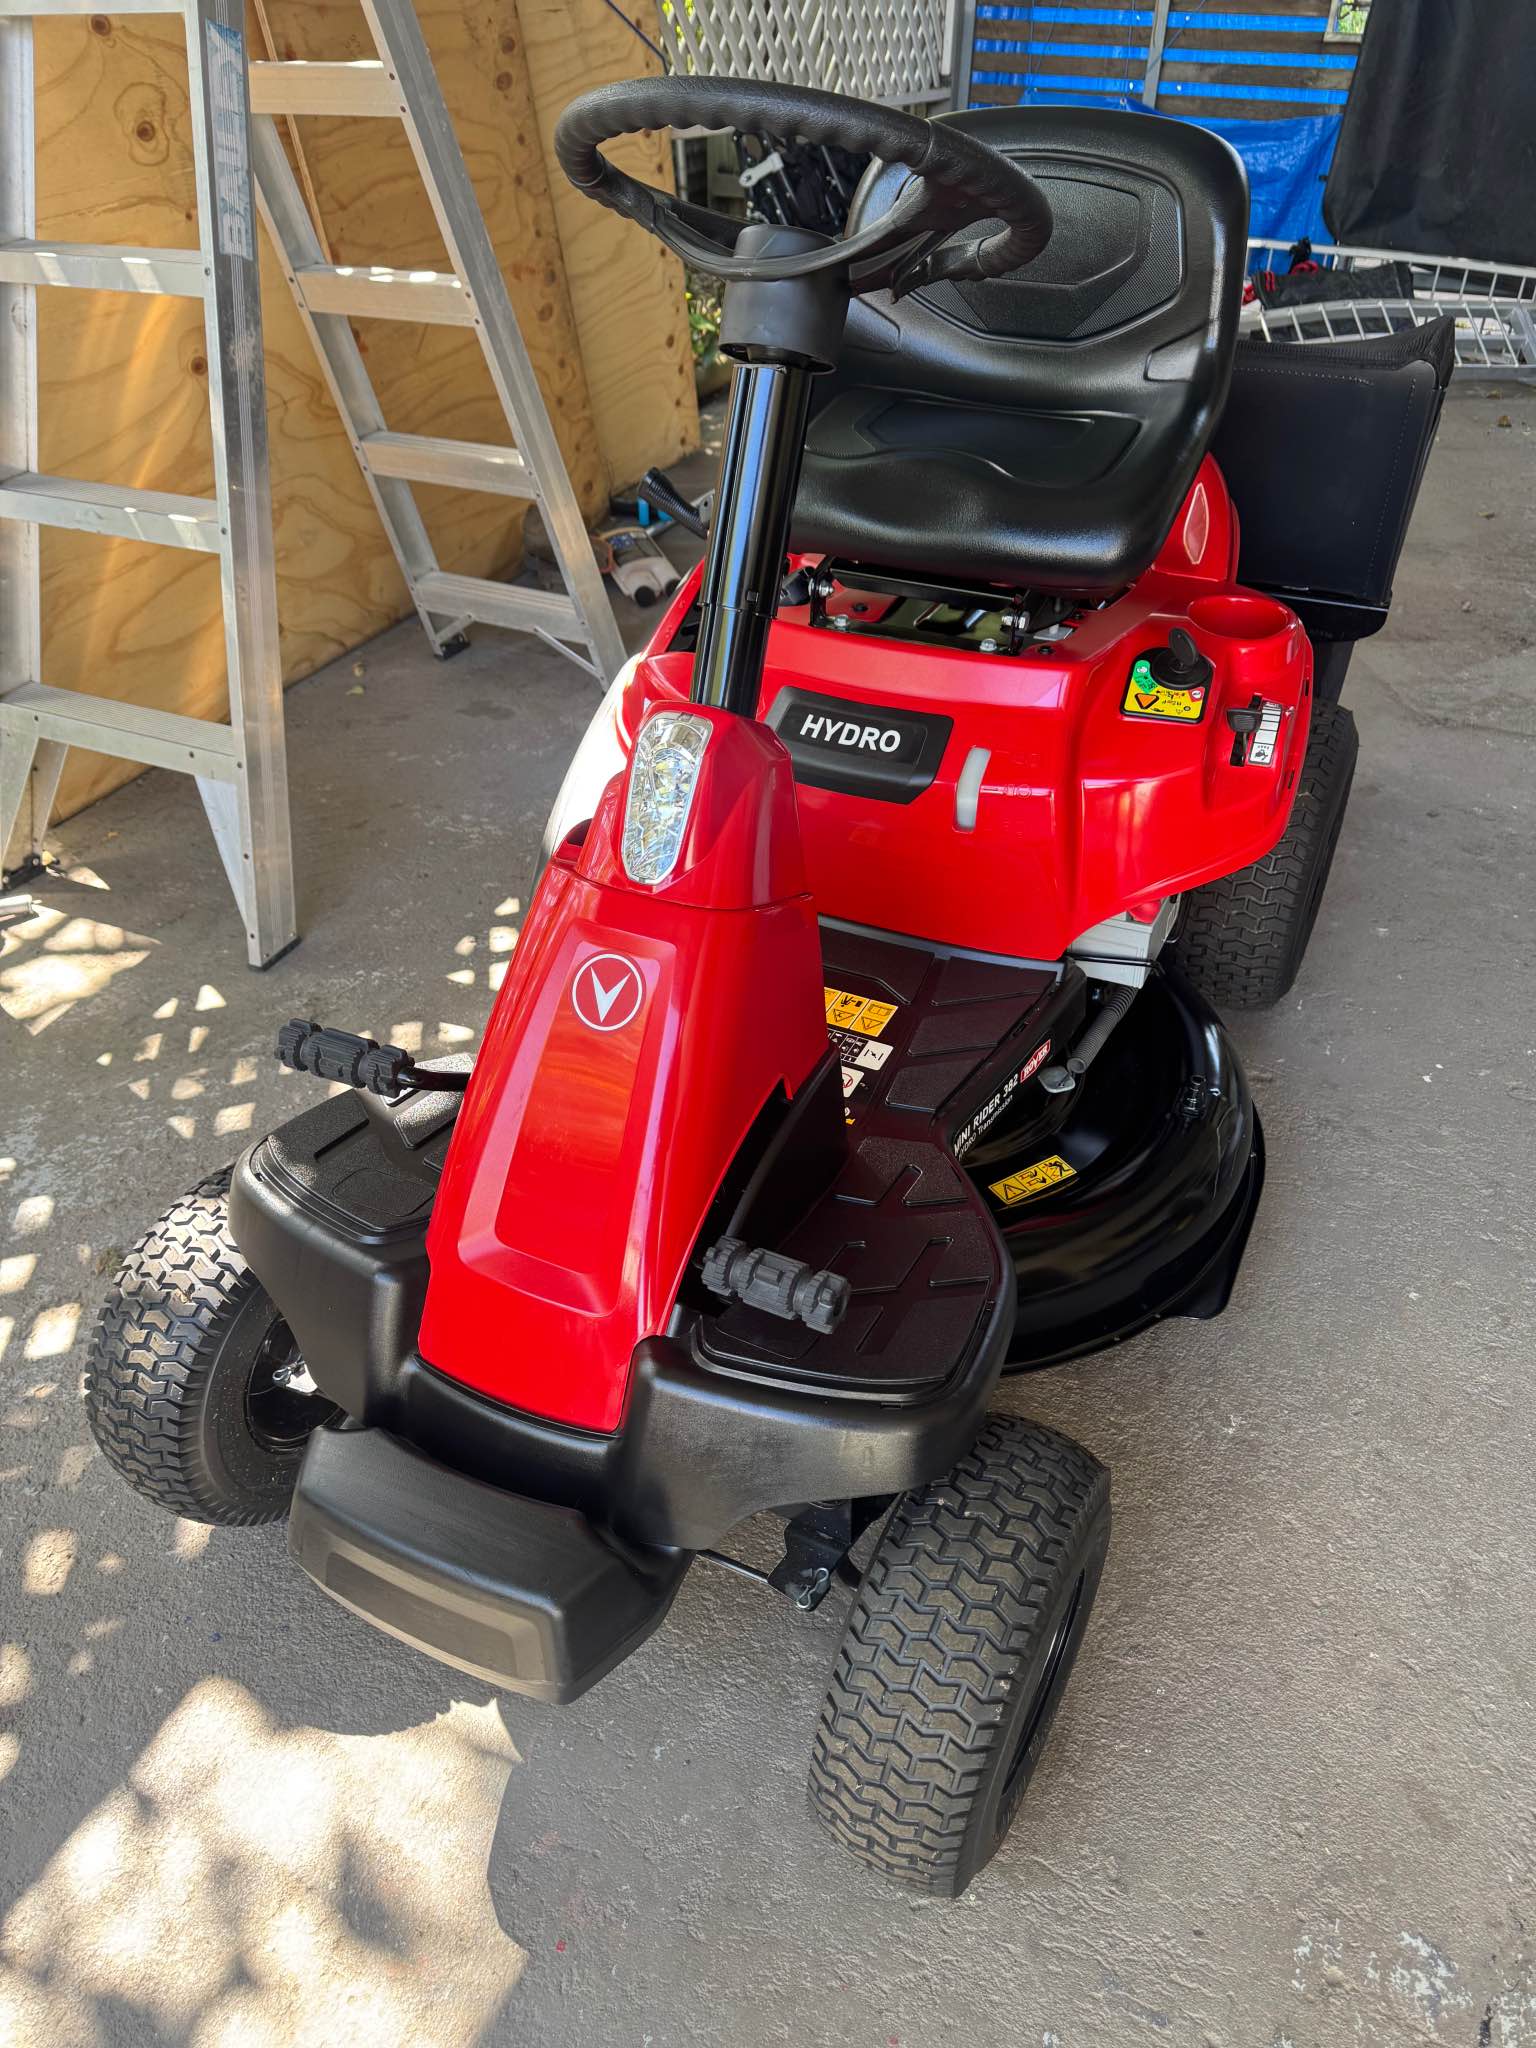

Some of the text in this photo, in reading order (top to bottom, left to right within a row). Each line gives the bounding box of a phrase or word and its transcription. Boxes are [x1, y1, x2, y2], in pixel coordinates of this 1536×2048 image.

[800, 714, 901, 753] HYDRO
[954, 1074, 1019, 1157] MINI RIDER 382
[978, 1095, 1013, 1135] Transmission
